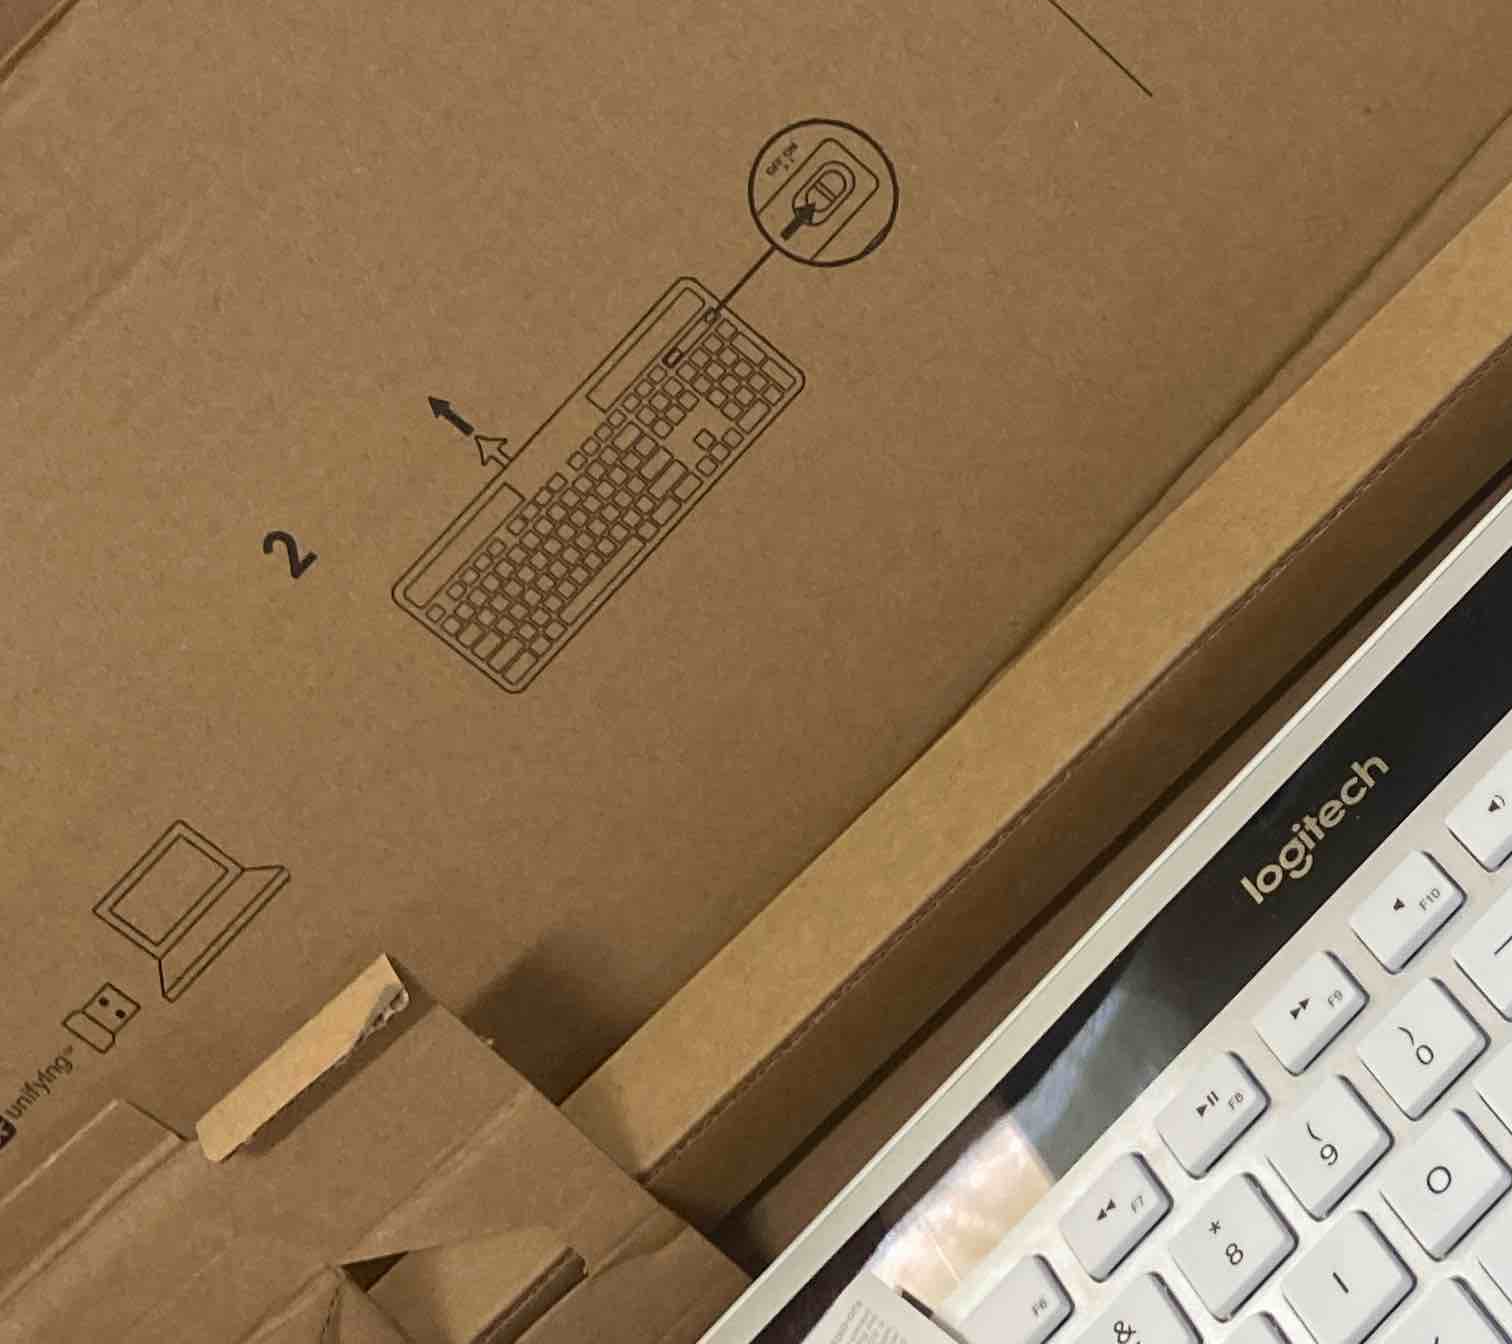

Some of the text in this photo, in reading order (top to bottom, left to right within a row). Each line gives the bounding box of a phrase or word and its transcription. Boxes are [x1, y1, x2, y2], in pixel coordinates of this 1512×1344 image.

[261, 529, 319, 581] 2
[1239, 755, 1390, 906] logitech
[1414, 1043, 1436, 1067] 0
[1318, 1142, 1340, 1167] 9
[1425, 1164, 1453, 1196] O
[1224, 1241, 1245, 1267] 8
